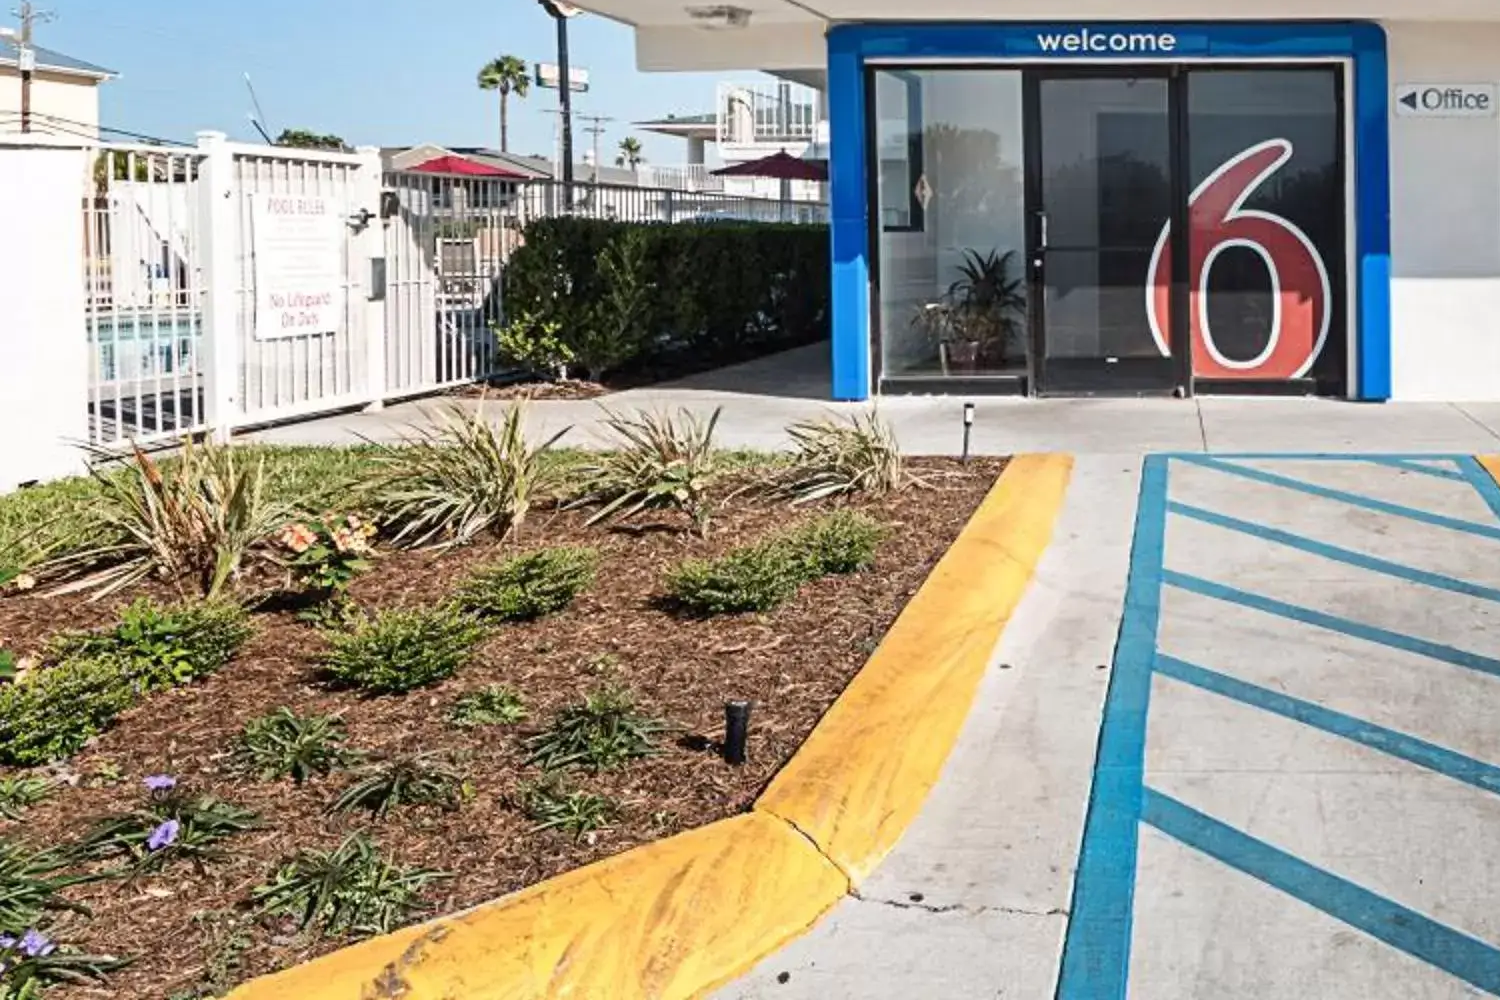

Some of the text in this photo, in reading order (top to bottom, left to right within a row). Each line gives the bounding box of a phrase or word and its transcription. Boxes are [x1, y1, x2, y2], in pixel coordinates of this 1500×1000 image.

[1037, 28, 1177, 51] welcome
[1421, 87, 1490, 110] Office
[1146, 138, 1332, 379] 6
